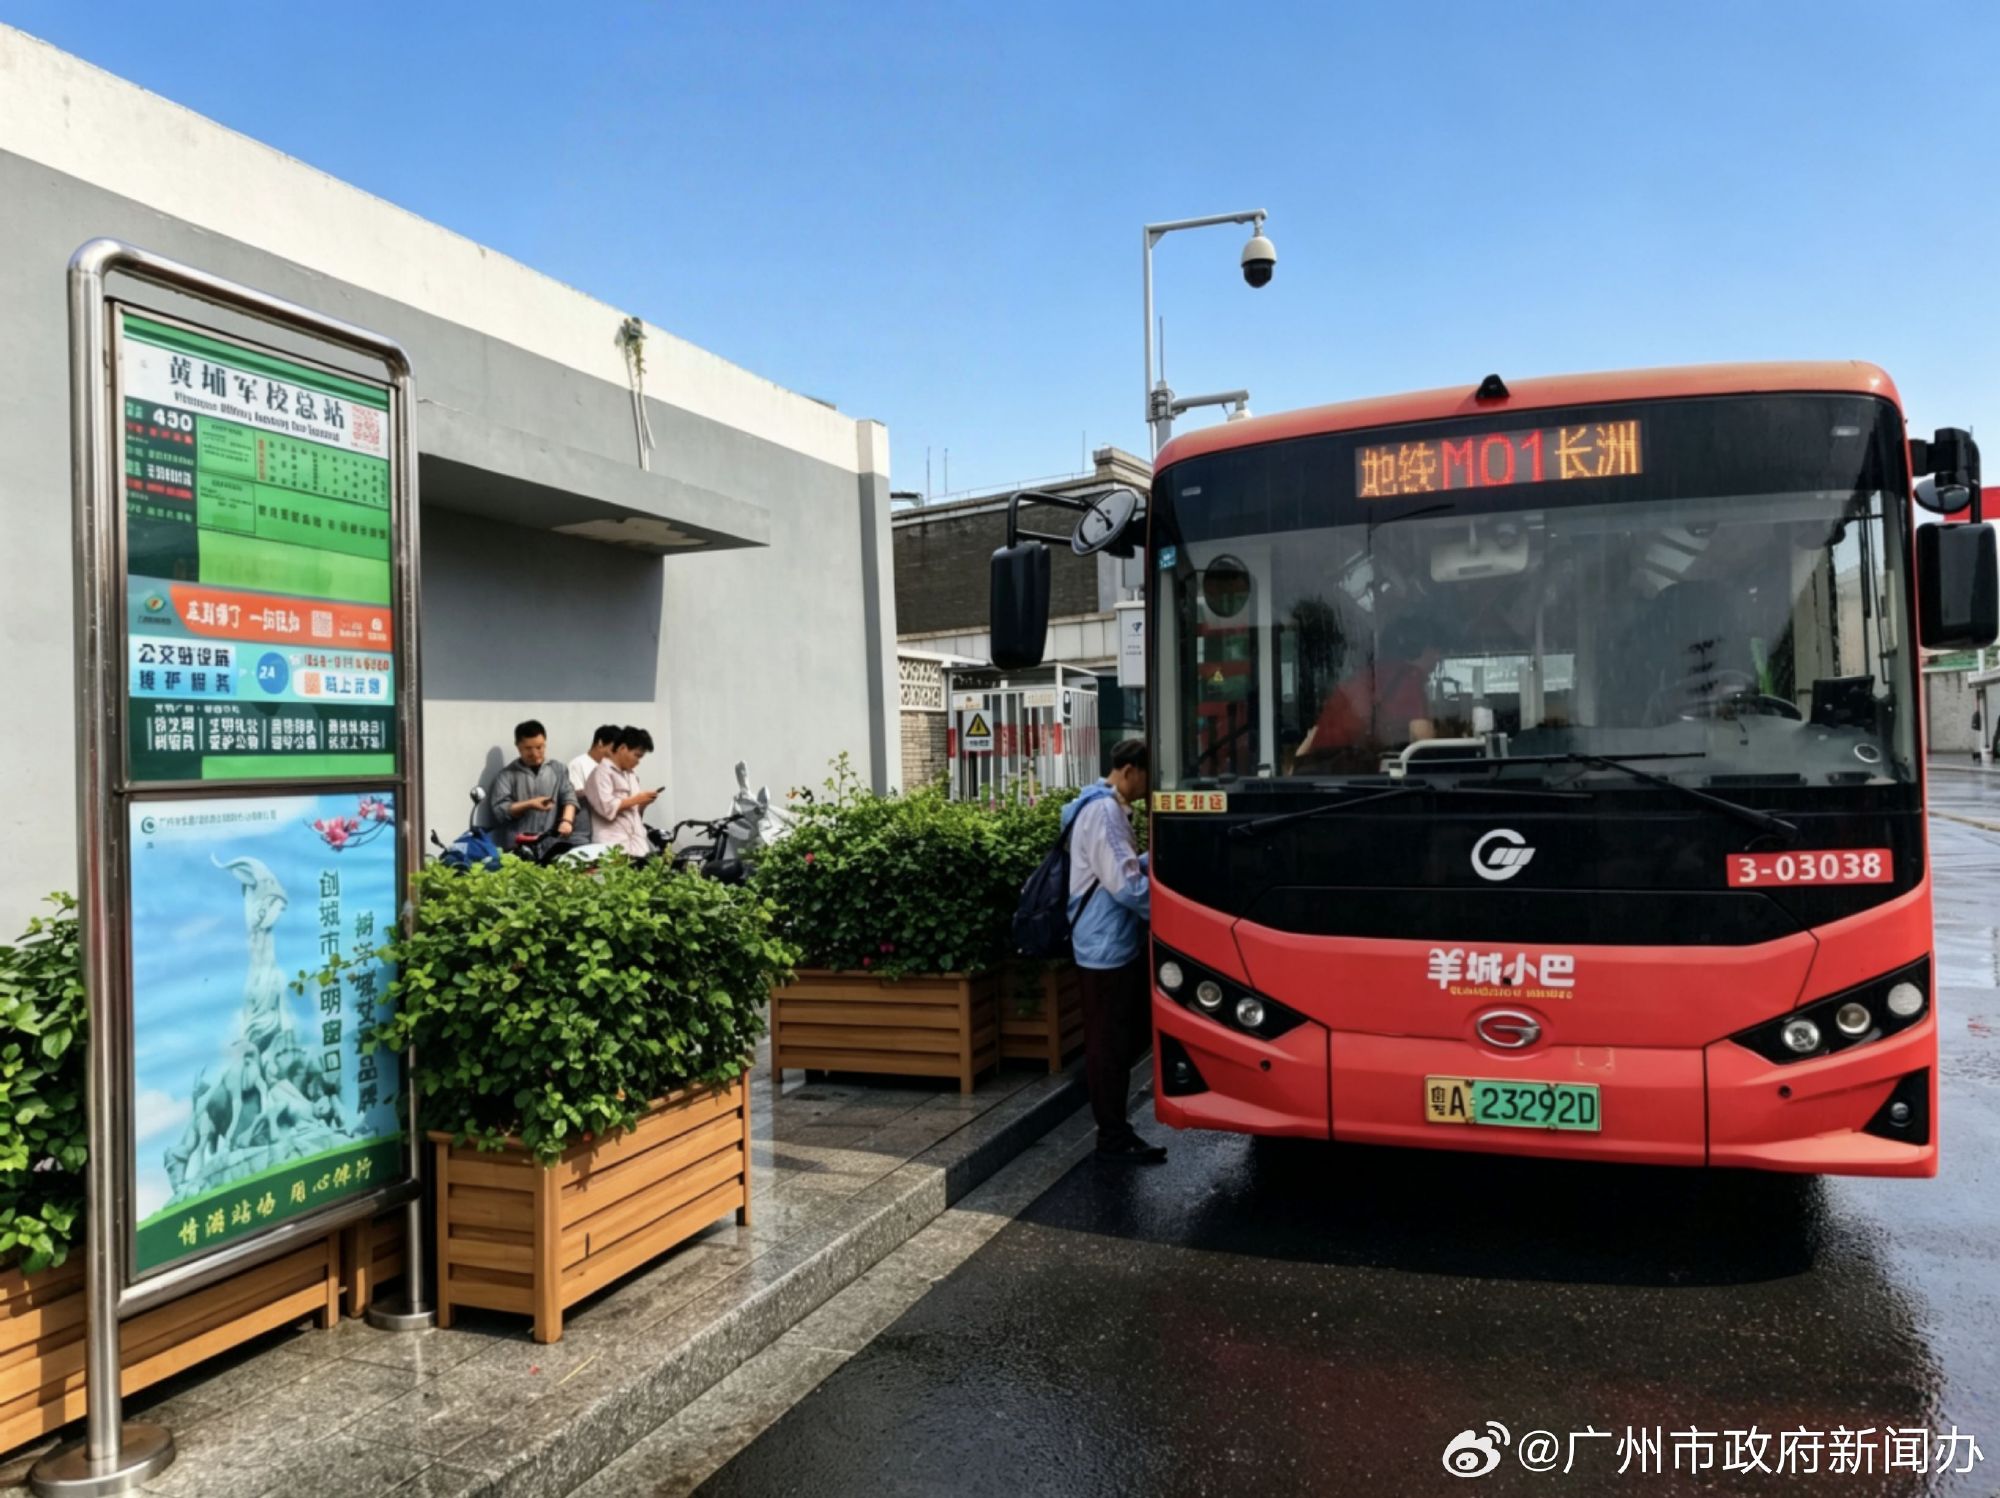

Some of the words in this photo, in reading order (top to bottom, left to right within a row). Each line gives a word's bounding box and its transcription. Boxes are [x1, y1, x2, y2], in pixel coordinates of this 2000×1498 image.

[170, 356, 344, 429] 黄埔军校总站
[1738, 853, 1882, 883] 3-03038
[319, 871, 342, 1073] 创城市明窗口
[1427, 948, 1576, 989] 羊城小巴
